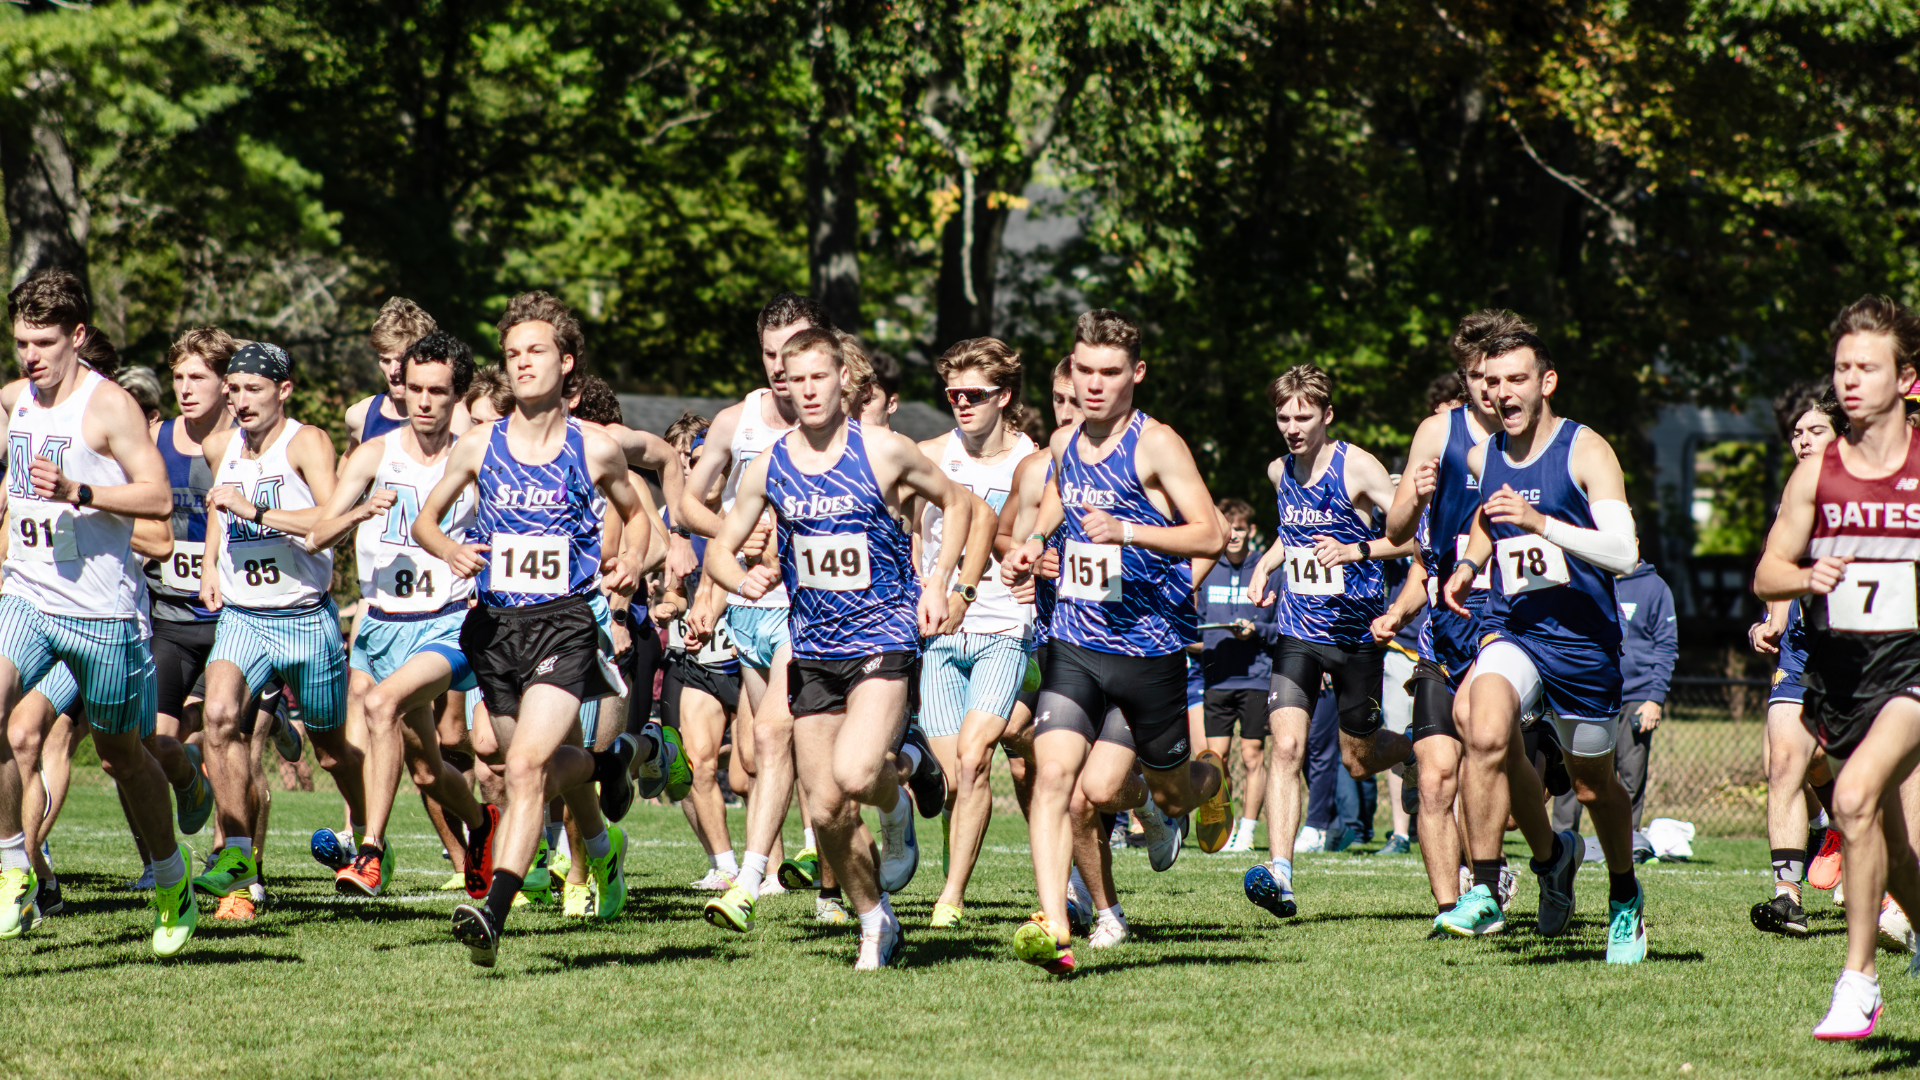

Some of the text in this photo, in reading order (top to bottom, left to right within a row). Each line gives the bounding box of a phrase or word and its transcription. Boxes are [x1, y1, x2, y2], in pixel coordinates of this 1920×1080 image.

[808, 494, 854, 518] JOE'S
[1822, 502, 1920, 529] BATES
[20, 517, 54, 548] 91
[173, 552, 203, 579] 65
[243, 557, 281, 587] 85
[501, 547, 561, 580] 145
[801, 547, 861, 577] 149
[1068, 553, 1109, 588] 151
[1290, 557, 1333, 584] 141
[1508, 547, 1548, 580] 78
[394, 569, 435, 599] 84
[1856, 580, 1880, 614] 7
